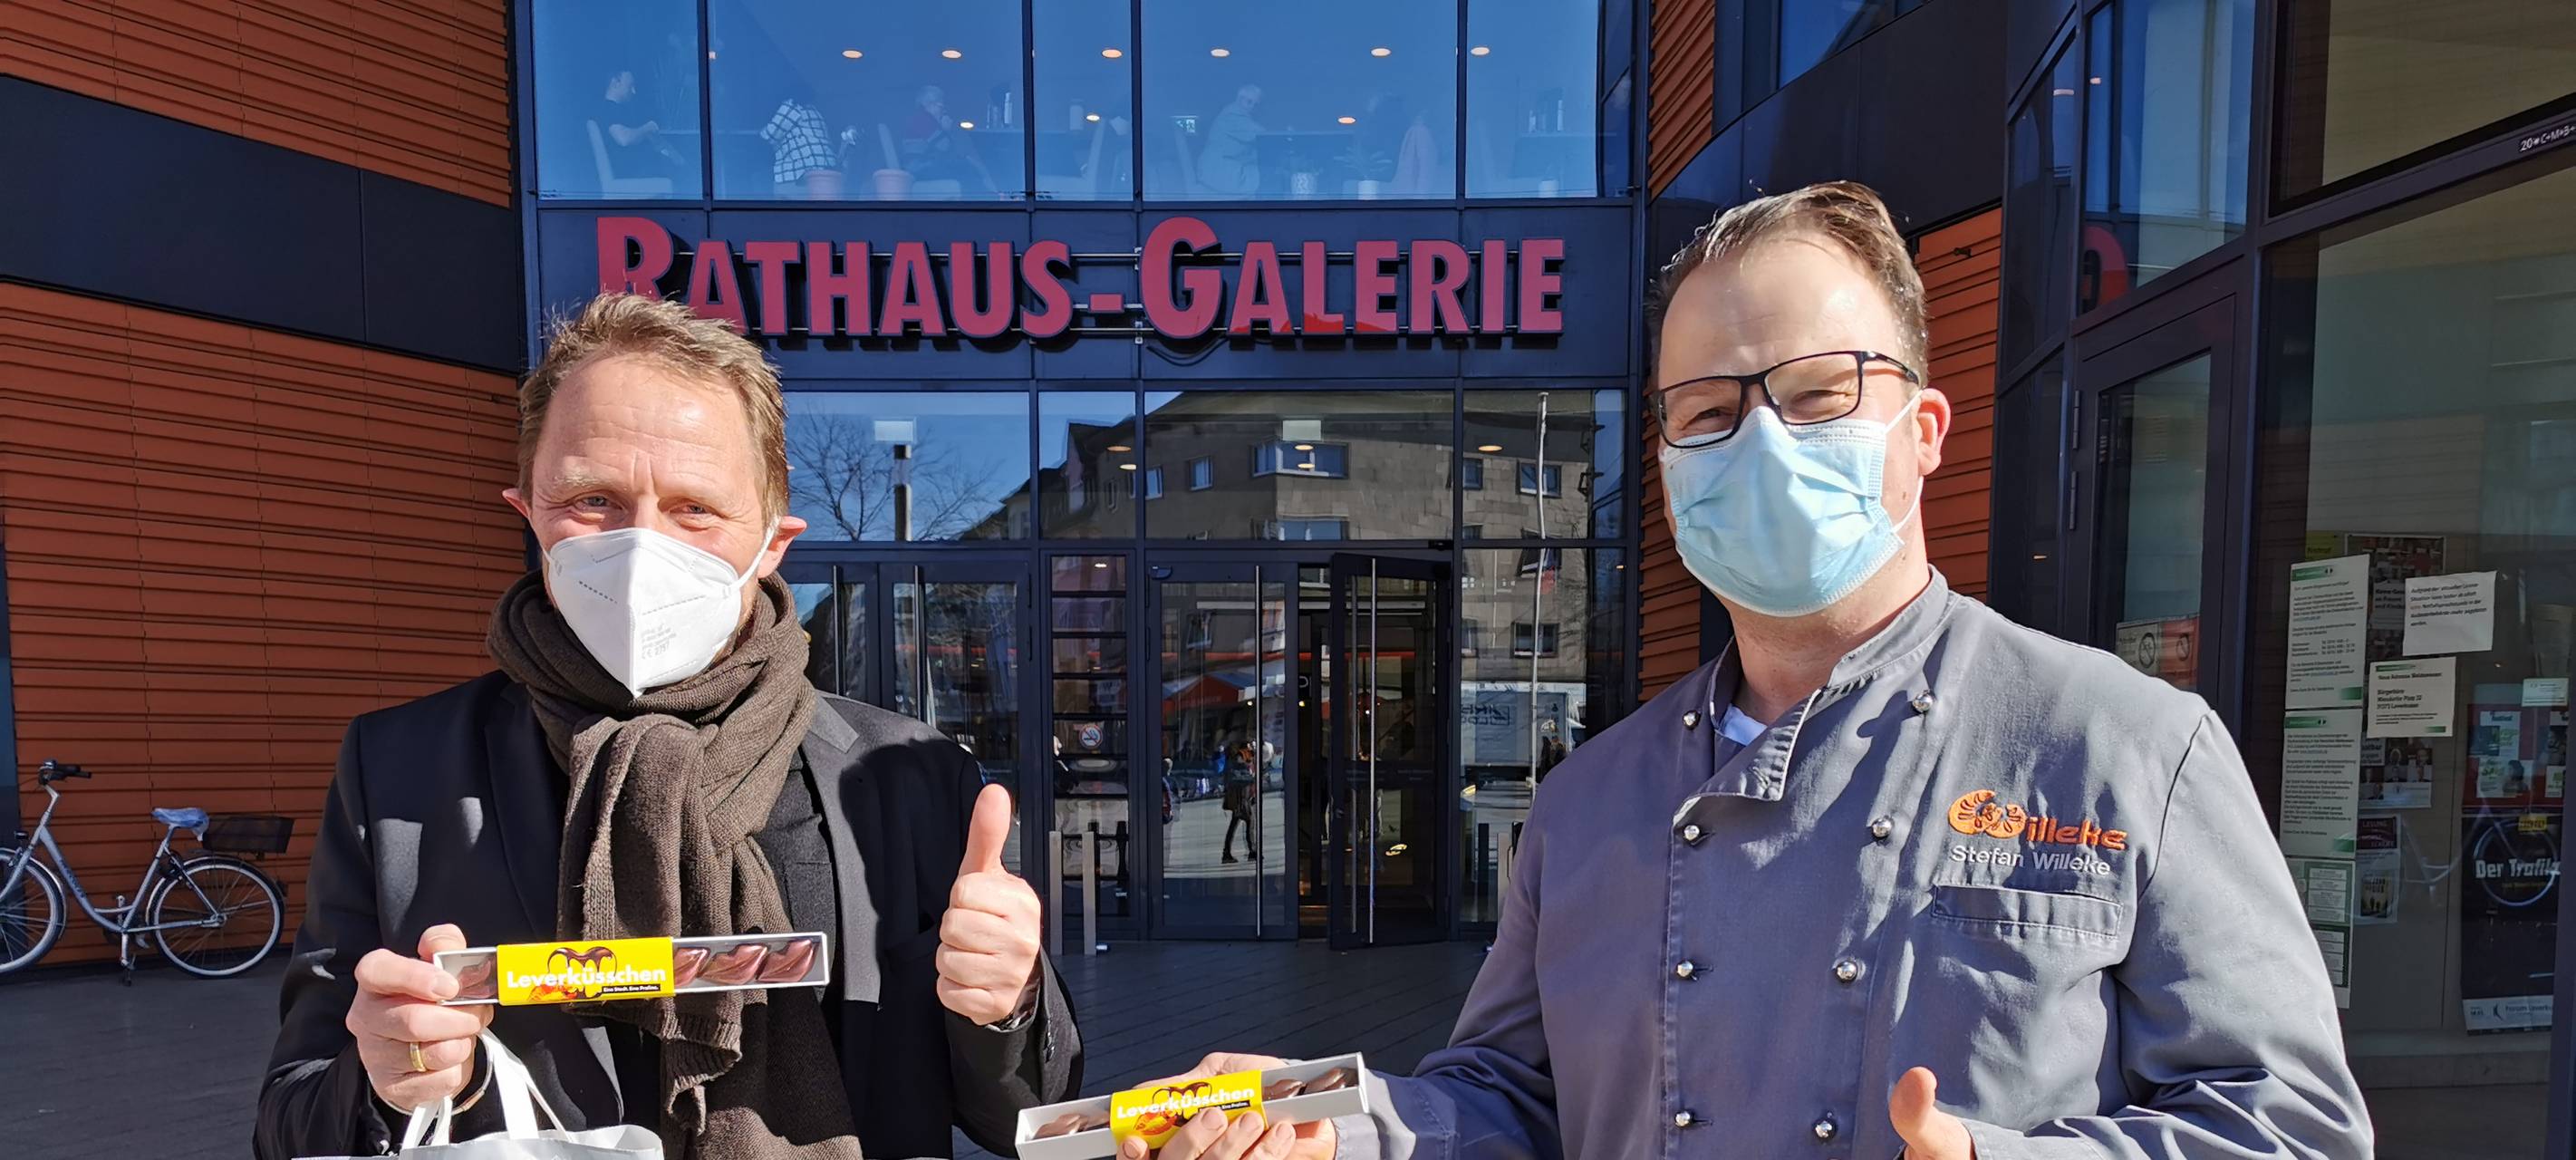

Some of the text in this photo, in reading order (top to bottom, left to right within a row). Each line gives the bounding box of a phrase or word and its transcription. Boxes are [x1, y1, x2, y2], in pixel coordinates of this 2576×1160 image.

[1951, 845, 2111, 876] Stefan Willeke
[2475, 860, 2504, 878] Der
[507, 965, 667, 989] Leverküsschen
[1117, 1088, 1256, 1119] Leverküsschen
